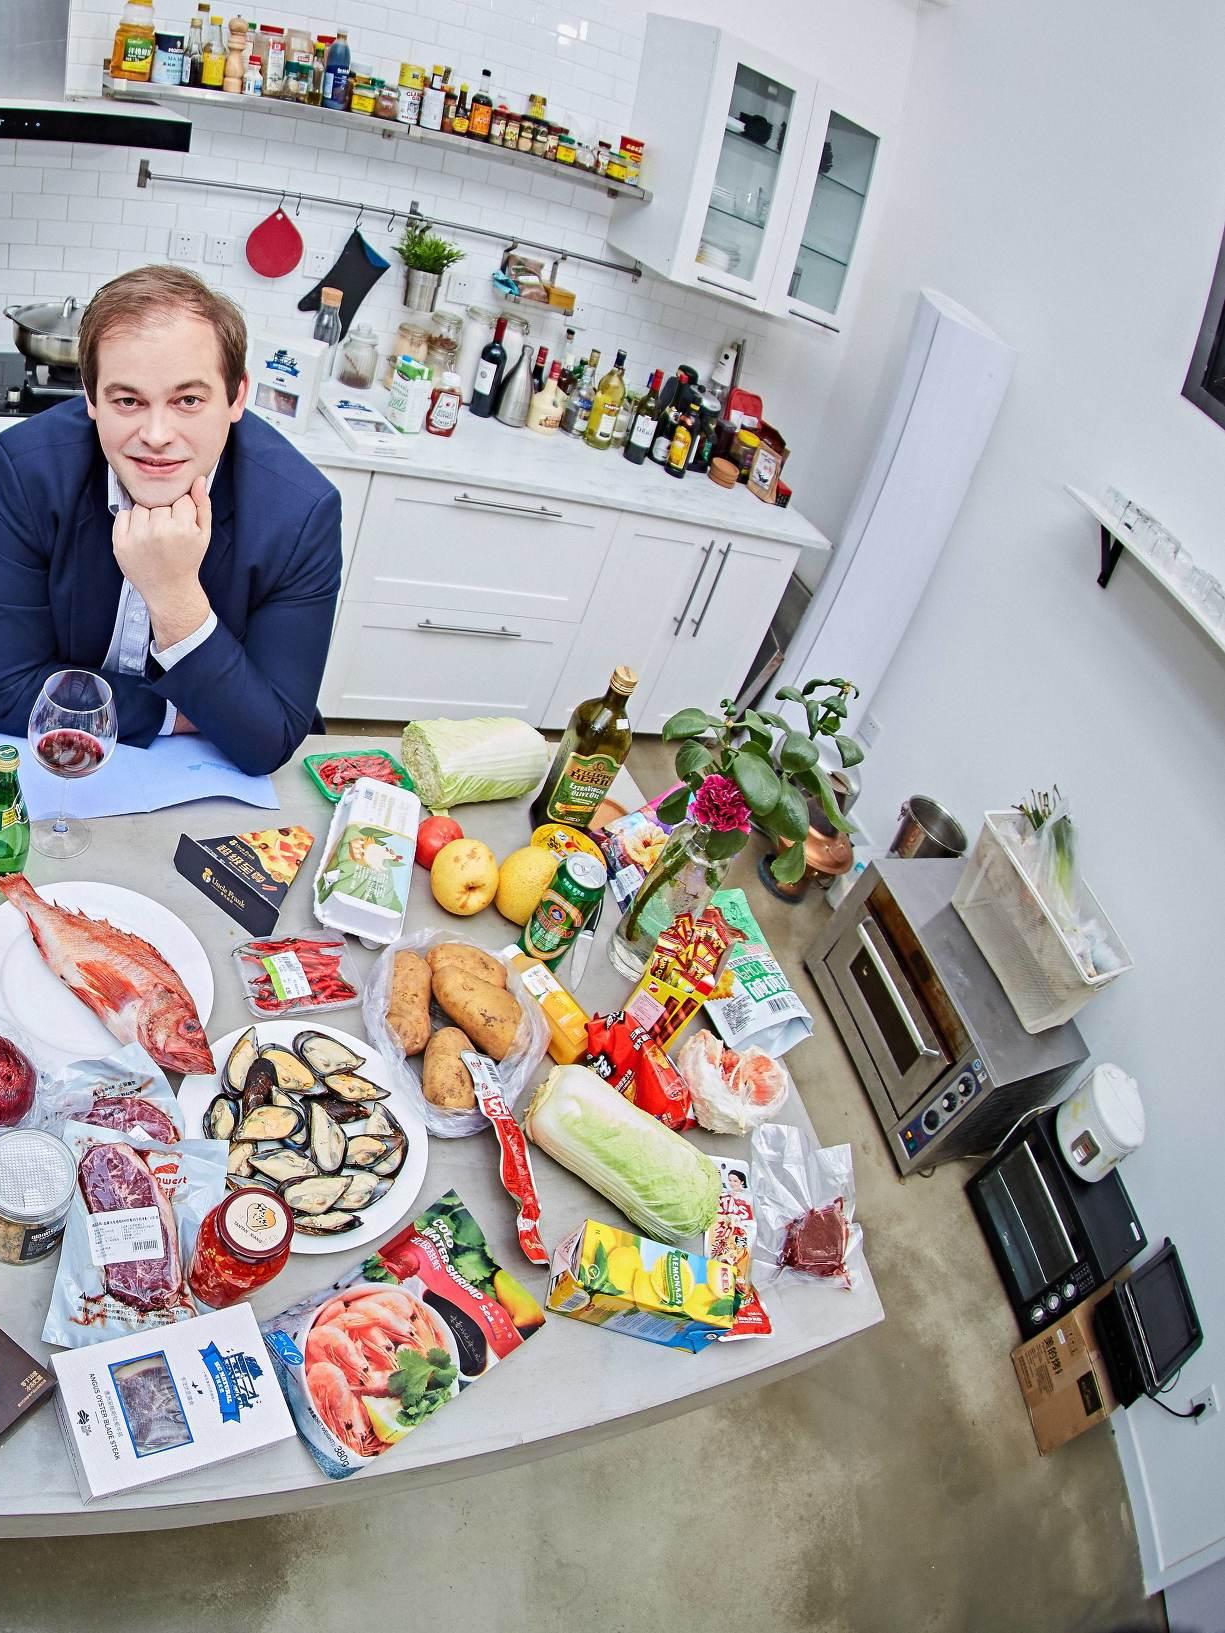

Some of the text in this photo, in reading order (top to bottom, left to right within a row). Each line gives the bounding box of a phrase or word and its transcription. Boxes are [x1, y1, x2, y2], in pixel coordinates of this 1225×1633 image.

[212, 877, 246, 908] Uncle Frank
[432, 1219, 454, 1249] COLD
[421, 1227, 450, 1264] WATER
[445, 1264, 483, 1300] SHRIMP
[89, 1373, 120, 1460] ANGUS OYSTER BLADE STEAK
[333, 1445, 350, 1467] 380g
